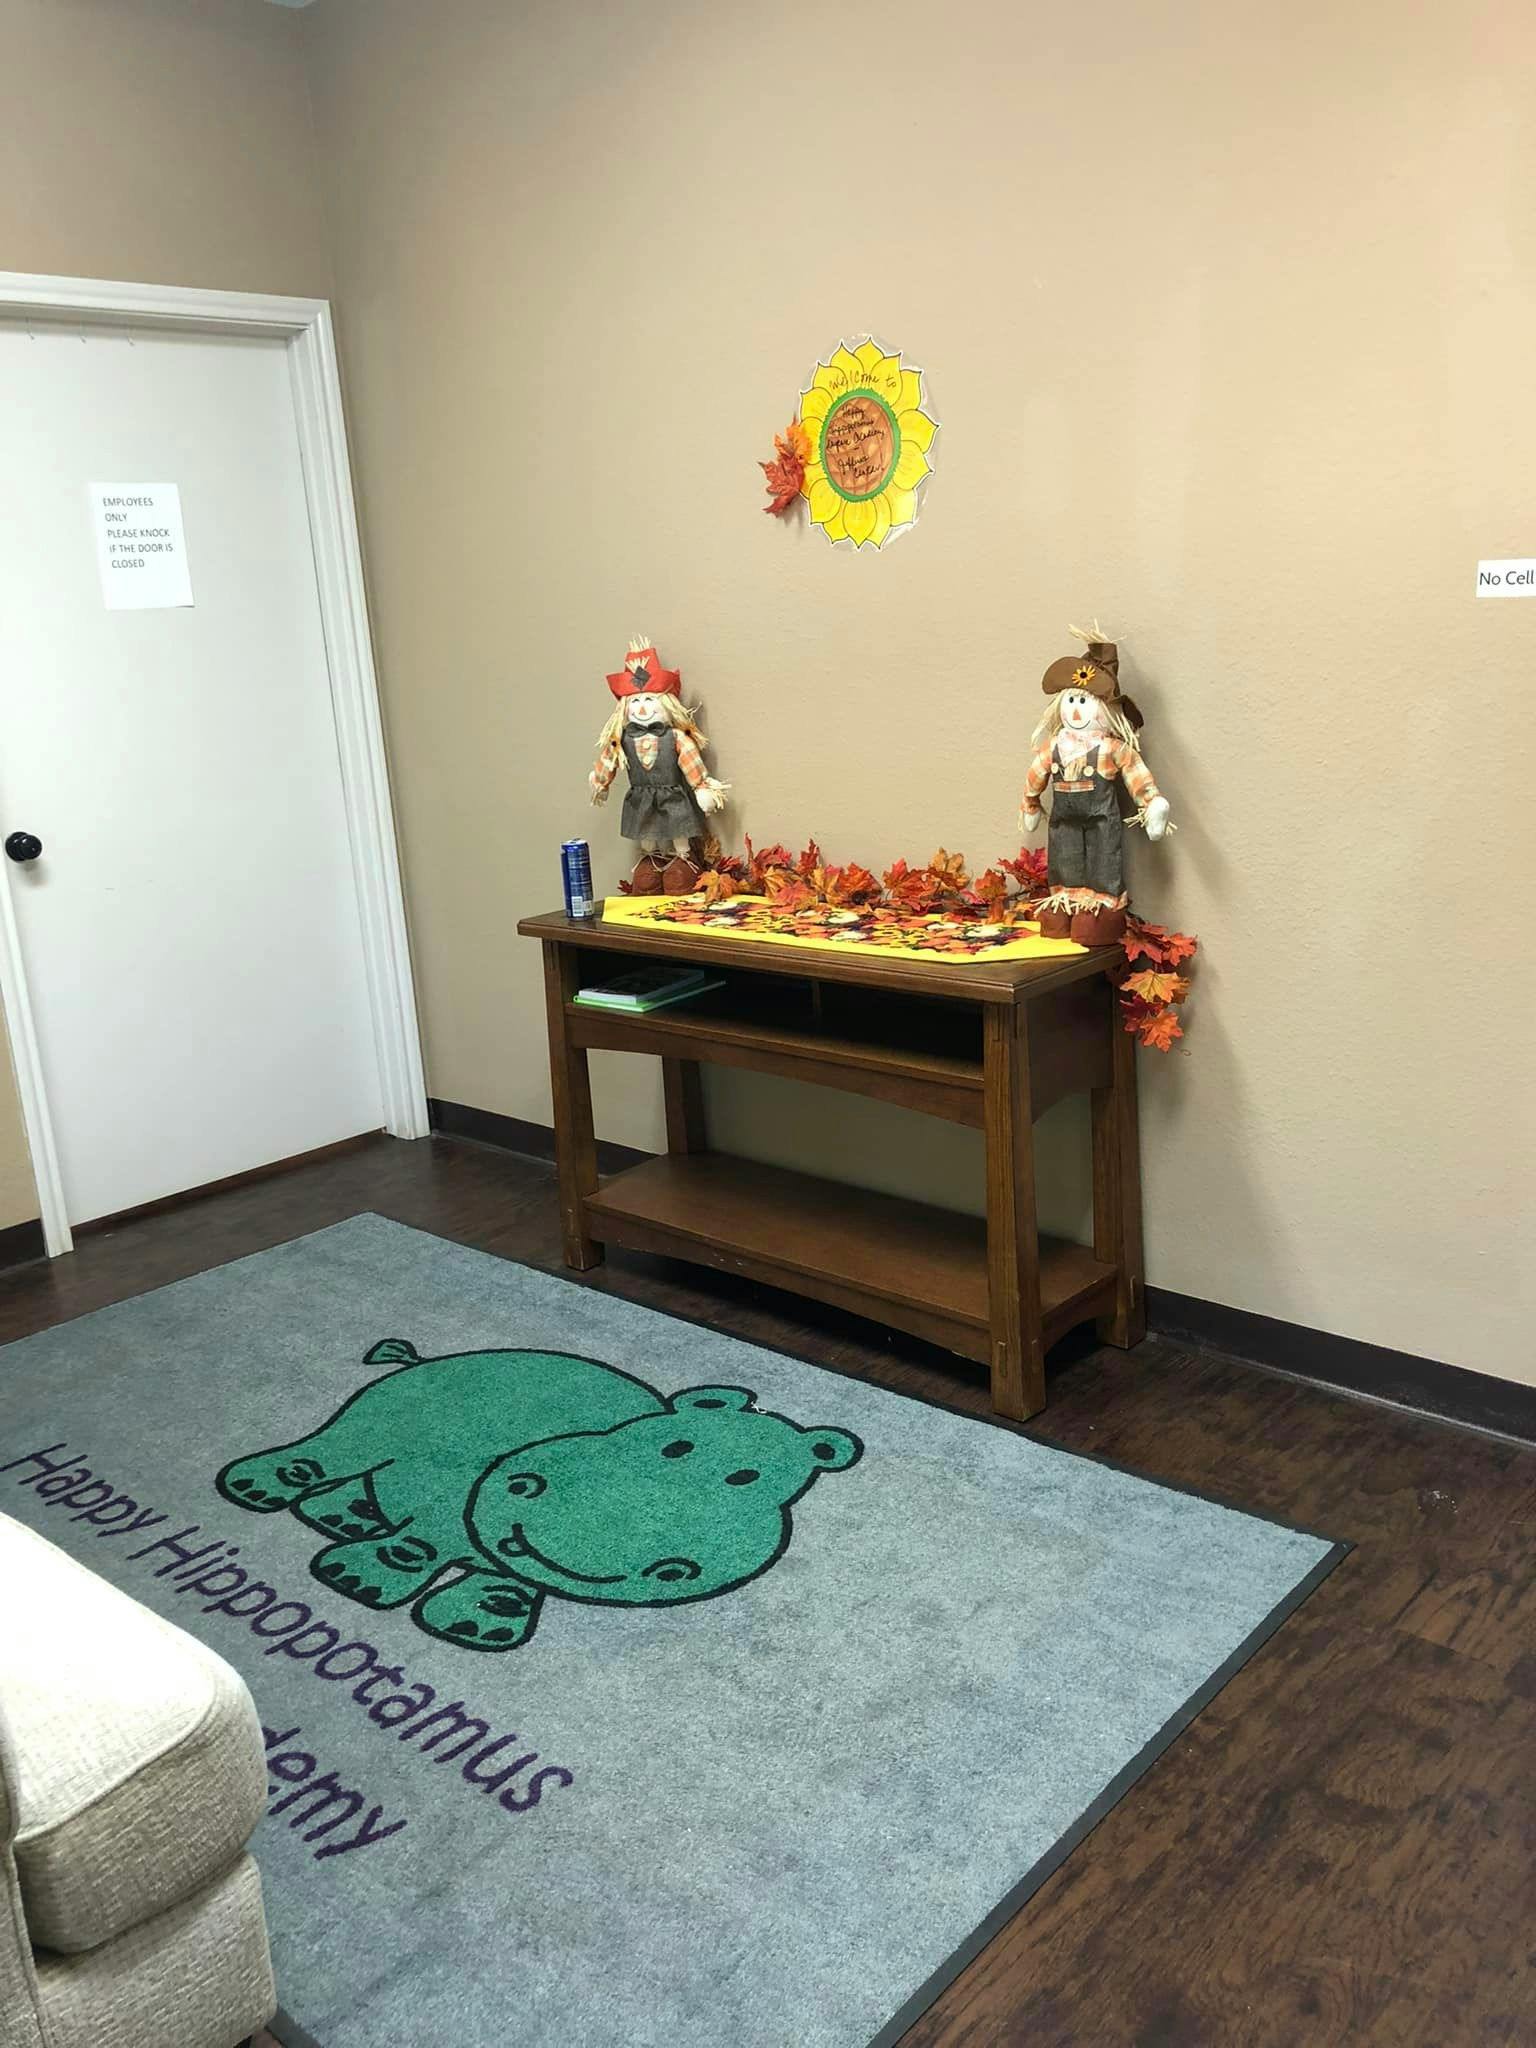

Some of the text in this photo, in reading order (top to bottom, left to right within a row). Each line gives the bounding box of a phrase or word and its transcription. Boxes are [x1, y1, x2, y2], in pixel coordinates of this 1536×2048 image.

[102, 497, 154, 507] EMPLOYEES
[104, 513, 128, 522] ONLY
[107, 528, 170, 538] PLEASE KNOCK
[109, 543, 174, 553] IF THE DOOR IS
[111, 559, 145, 568] CLOSED
[1479, 569, 1535, 586] No Cell
[0, 1443, 574, 1813] Happy Hippopotamus
